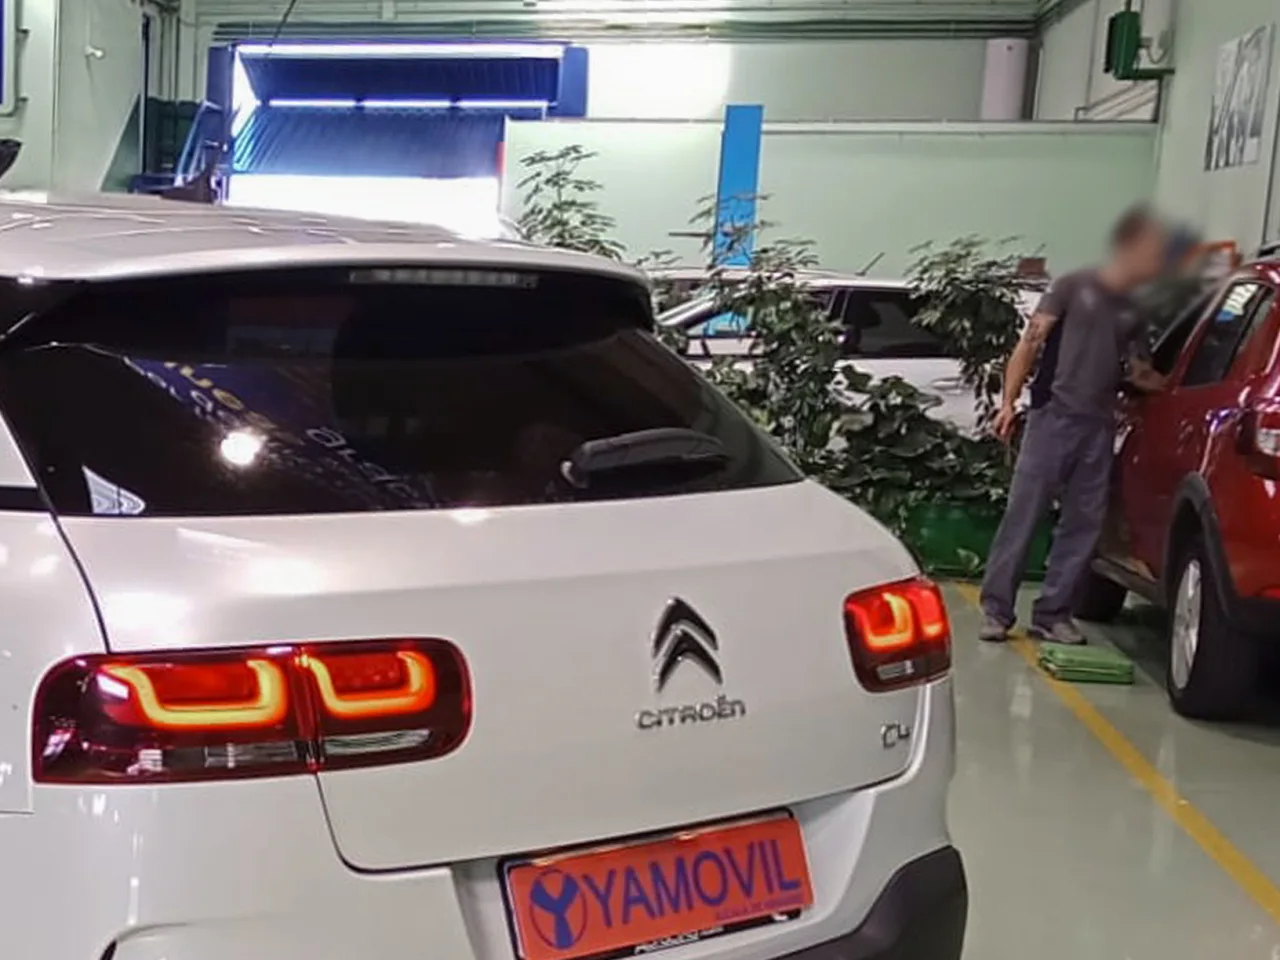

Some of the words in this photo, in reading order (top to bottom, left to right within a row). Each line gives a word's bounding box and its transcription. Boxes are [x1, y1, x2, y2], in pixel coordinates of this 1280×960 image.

[635, 695, 747, 730] CITROËN
[881, 723, 911, 749] C4
[582, 839, 802, 928] YAMOVIL
